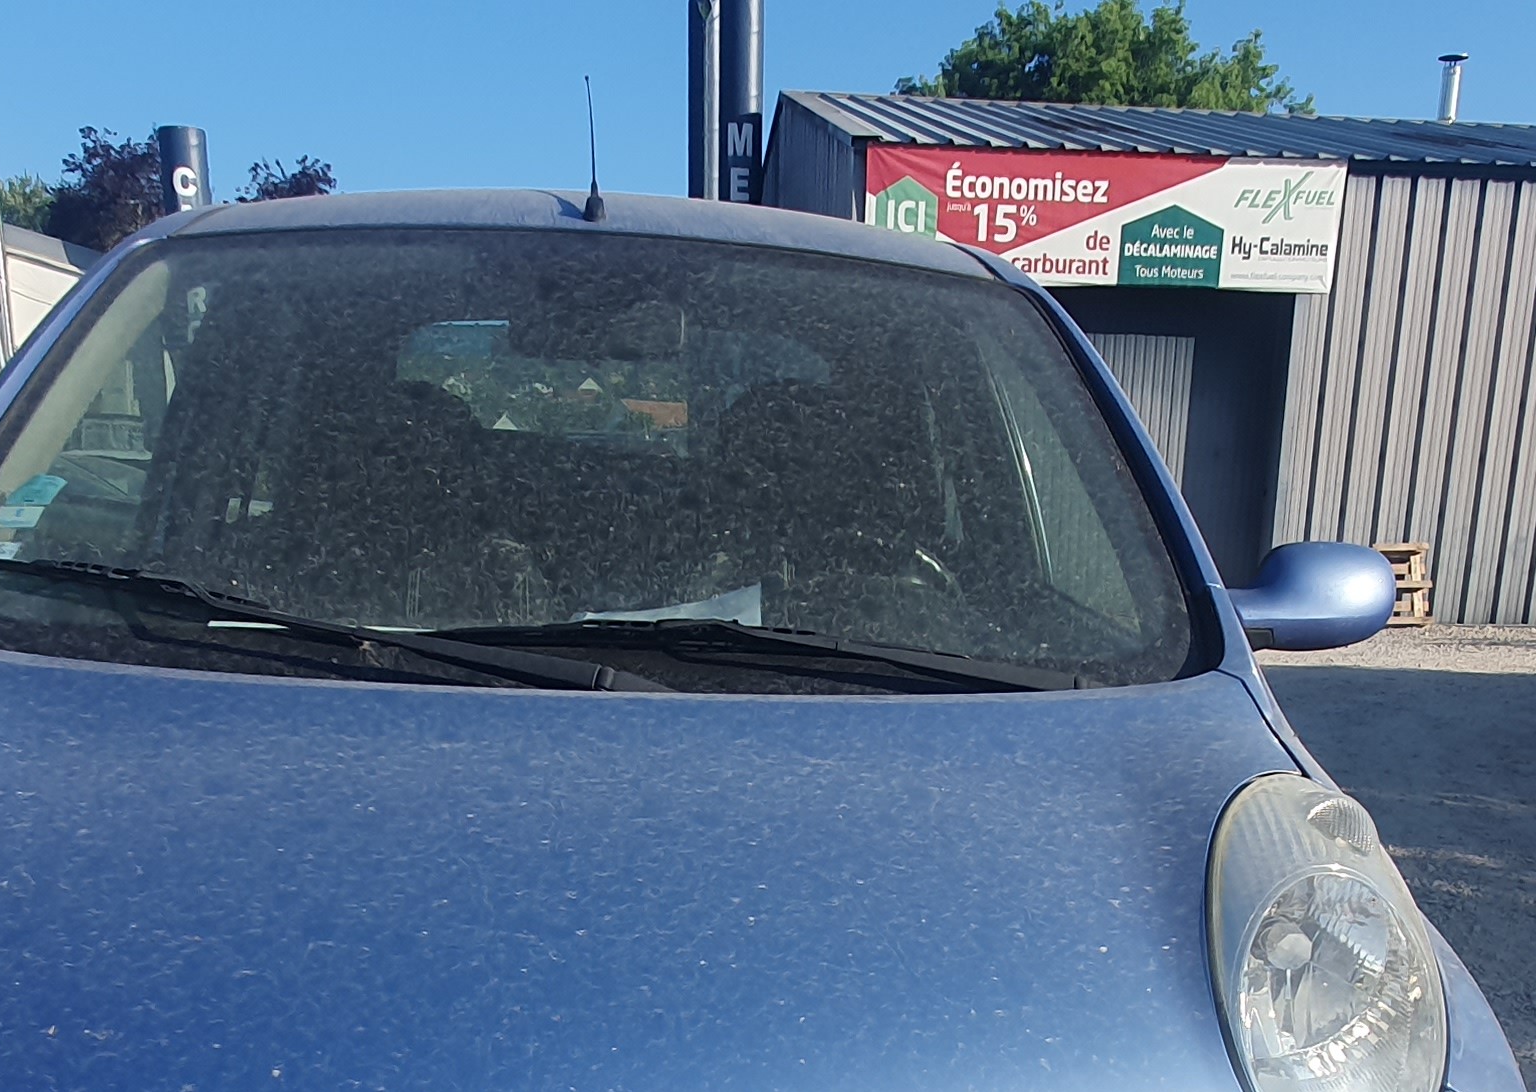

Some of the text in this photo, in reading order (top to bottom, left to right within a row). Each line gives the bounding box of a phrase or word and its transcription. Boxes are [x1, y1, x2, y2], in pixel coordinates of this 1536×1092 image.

[945, 161, 1110, 203] Économisez
[1233, 170, 1336, 225] FLEXFUEL
[887, 199, 927, 233] ICI
[1085, 230, 1111, 251] de
[1151, 224, 1195, 240] Avec le
[1124, 240, 1218, 260] DÉCALAMINAGE
[1231, 235, 1329, 261] Hy-Calamine
[1011, 253, 1109, 276] carburant
[1135, 264, 1204, 280] Tous Moteurs
